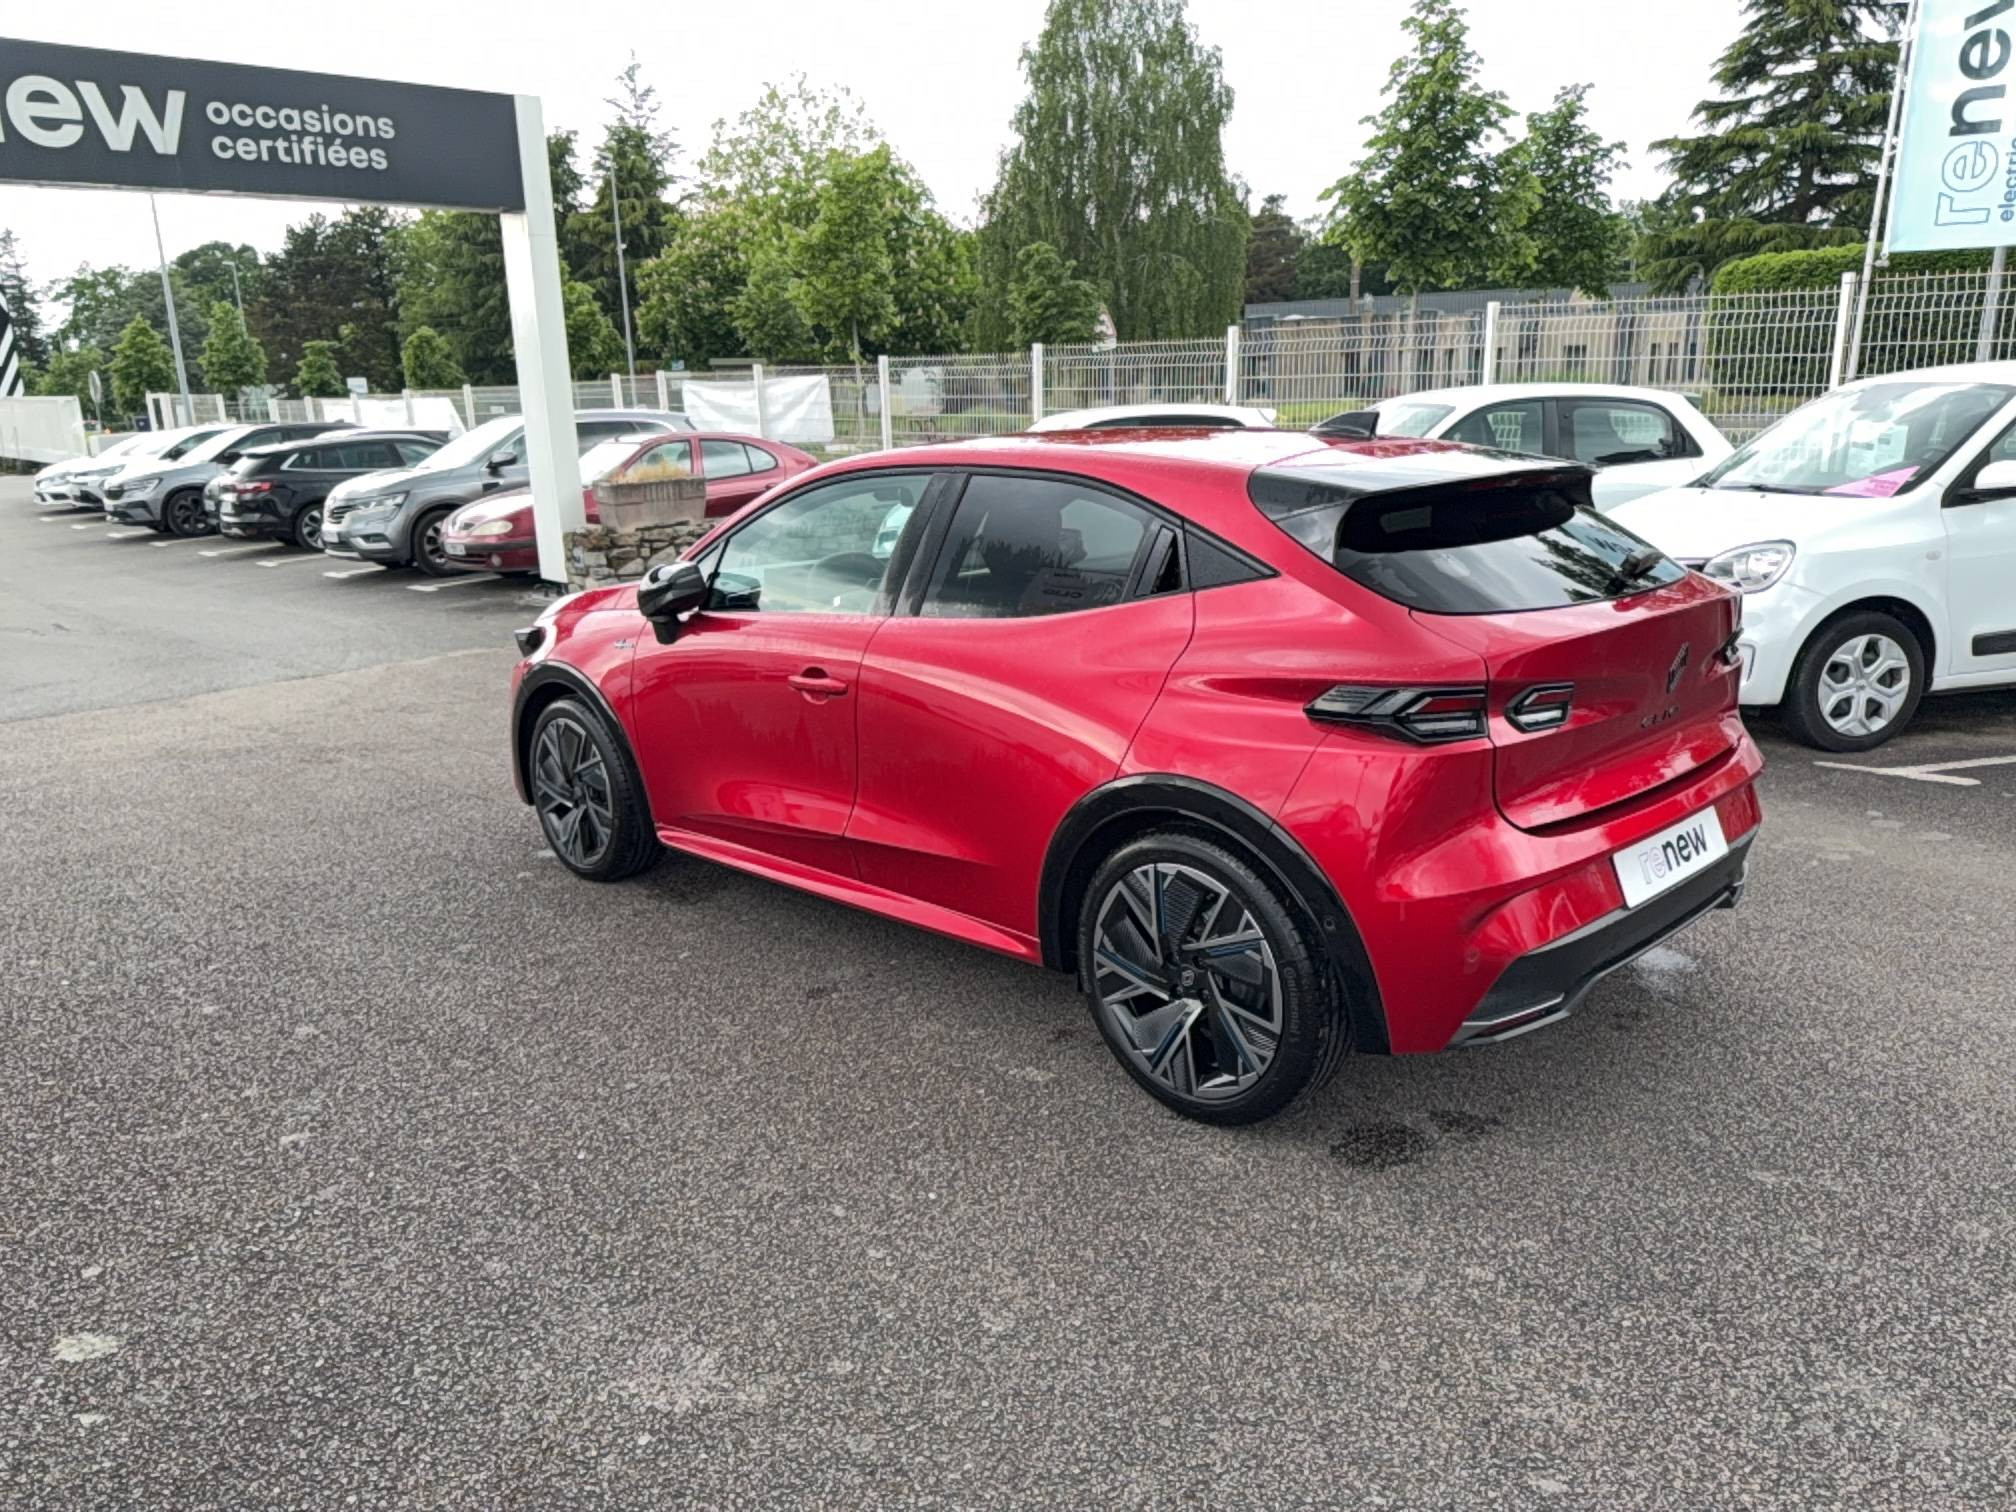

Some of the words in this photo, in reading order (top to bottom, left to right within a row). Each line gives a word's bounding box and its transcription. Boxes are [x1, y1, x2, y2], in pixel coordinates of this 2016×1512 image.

[0, 74, 186, 155] ew
[206, 100, 396, 140] occasions
[211, 132, 389, 171] certifiées
[1638, 823, 1708, 885] renew
